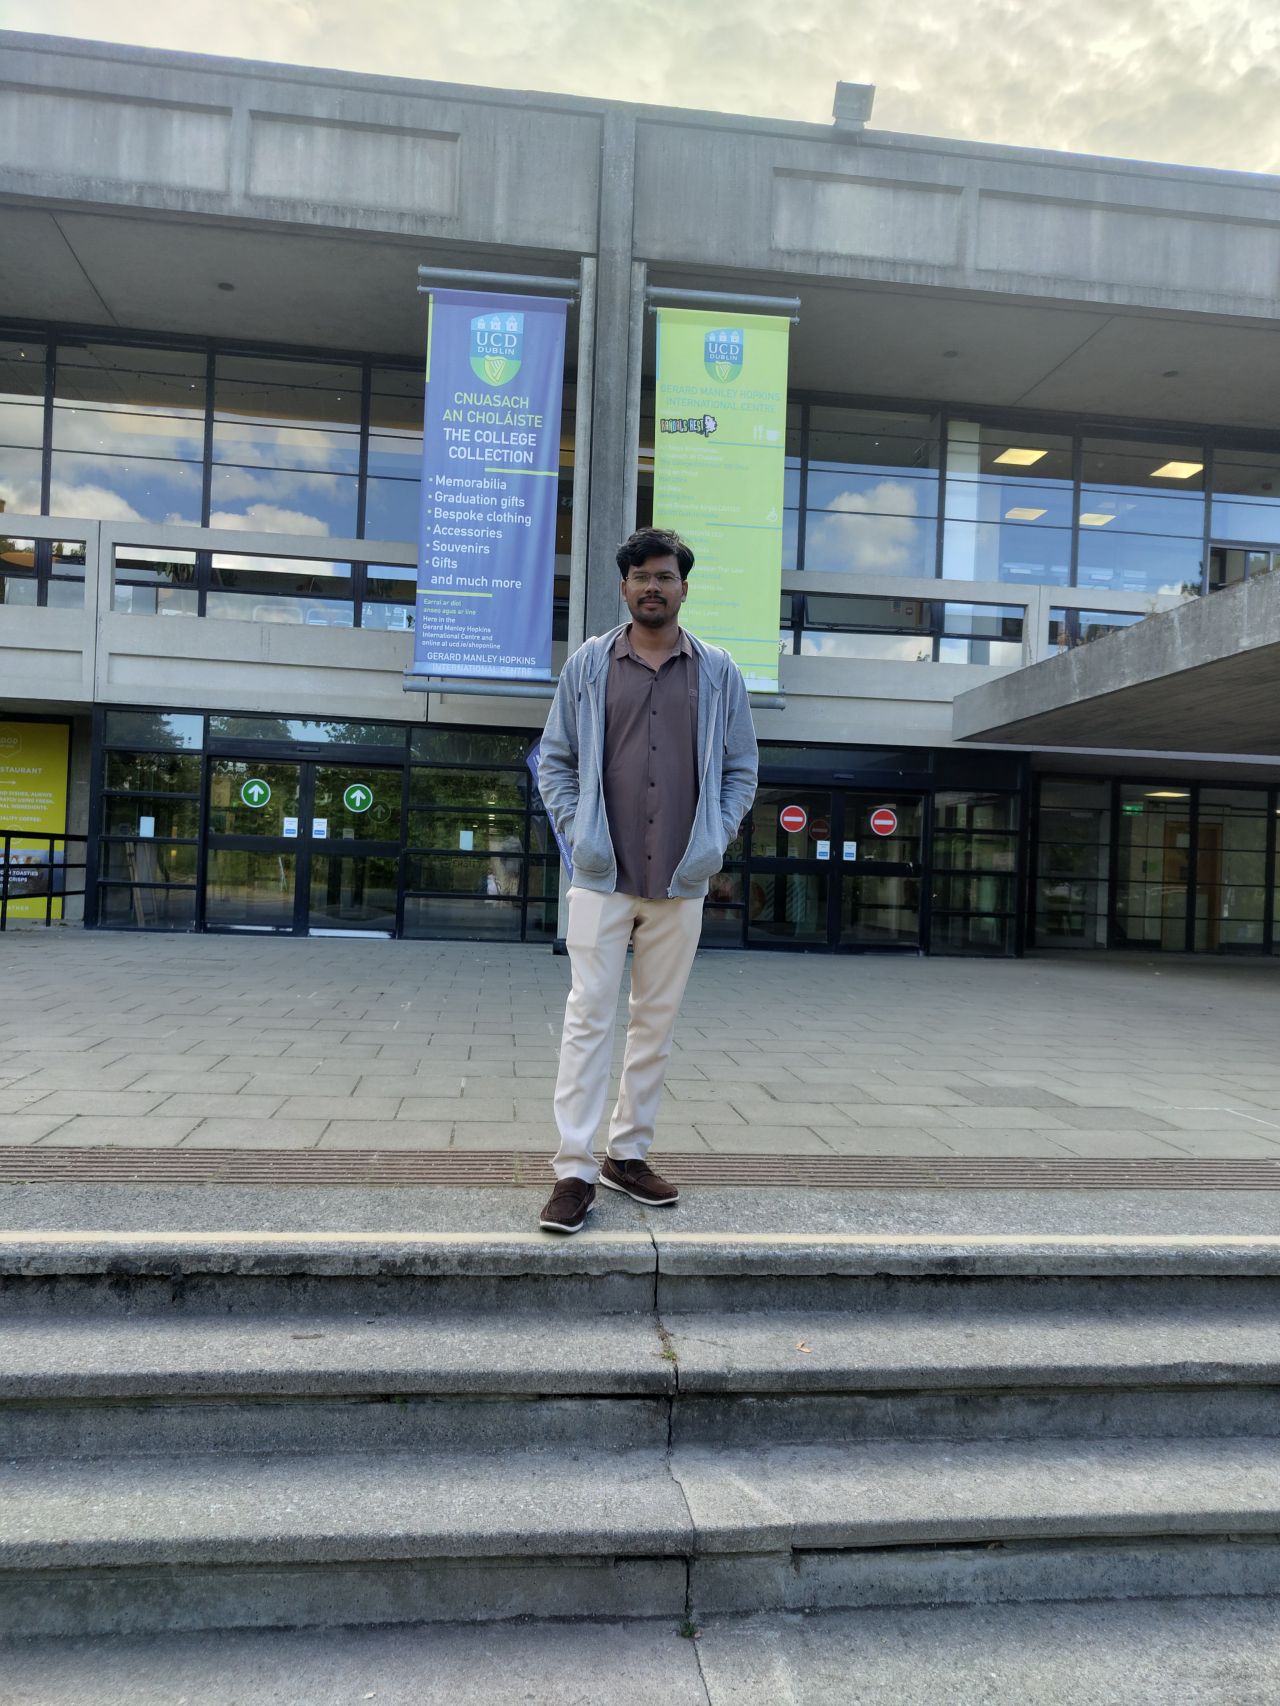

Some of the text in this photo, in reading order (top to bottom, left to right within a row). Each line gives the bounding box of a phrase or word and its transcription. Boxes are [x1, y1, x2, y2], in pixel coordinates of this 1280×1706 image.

[476, 332, 517, 348] UCD
[708, 343, 740, 355] UCD
[454, 392, 529, 409] CNUASACH
[442, 410, 543, 428] AN CHOLÁISTE
[443, 428, 537, 446] THE COLLEGE
[449, 446, 534, 464] COLLECTION
[435, 475, 507, 490] Memorabilia
[434, 491, 525, 509] Graduation gifts
[434, 507, 532, 527] Bespoke clothing
[432, 524, 503, 538] Accessories
[432, 541, 490, 554] Souvenirs
[431, 557, 458, 569] Gifts
[431, 574, 522, 588] and much more
[427, 652, 536, 665] GERARD MANLEY HOPKINS
